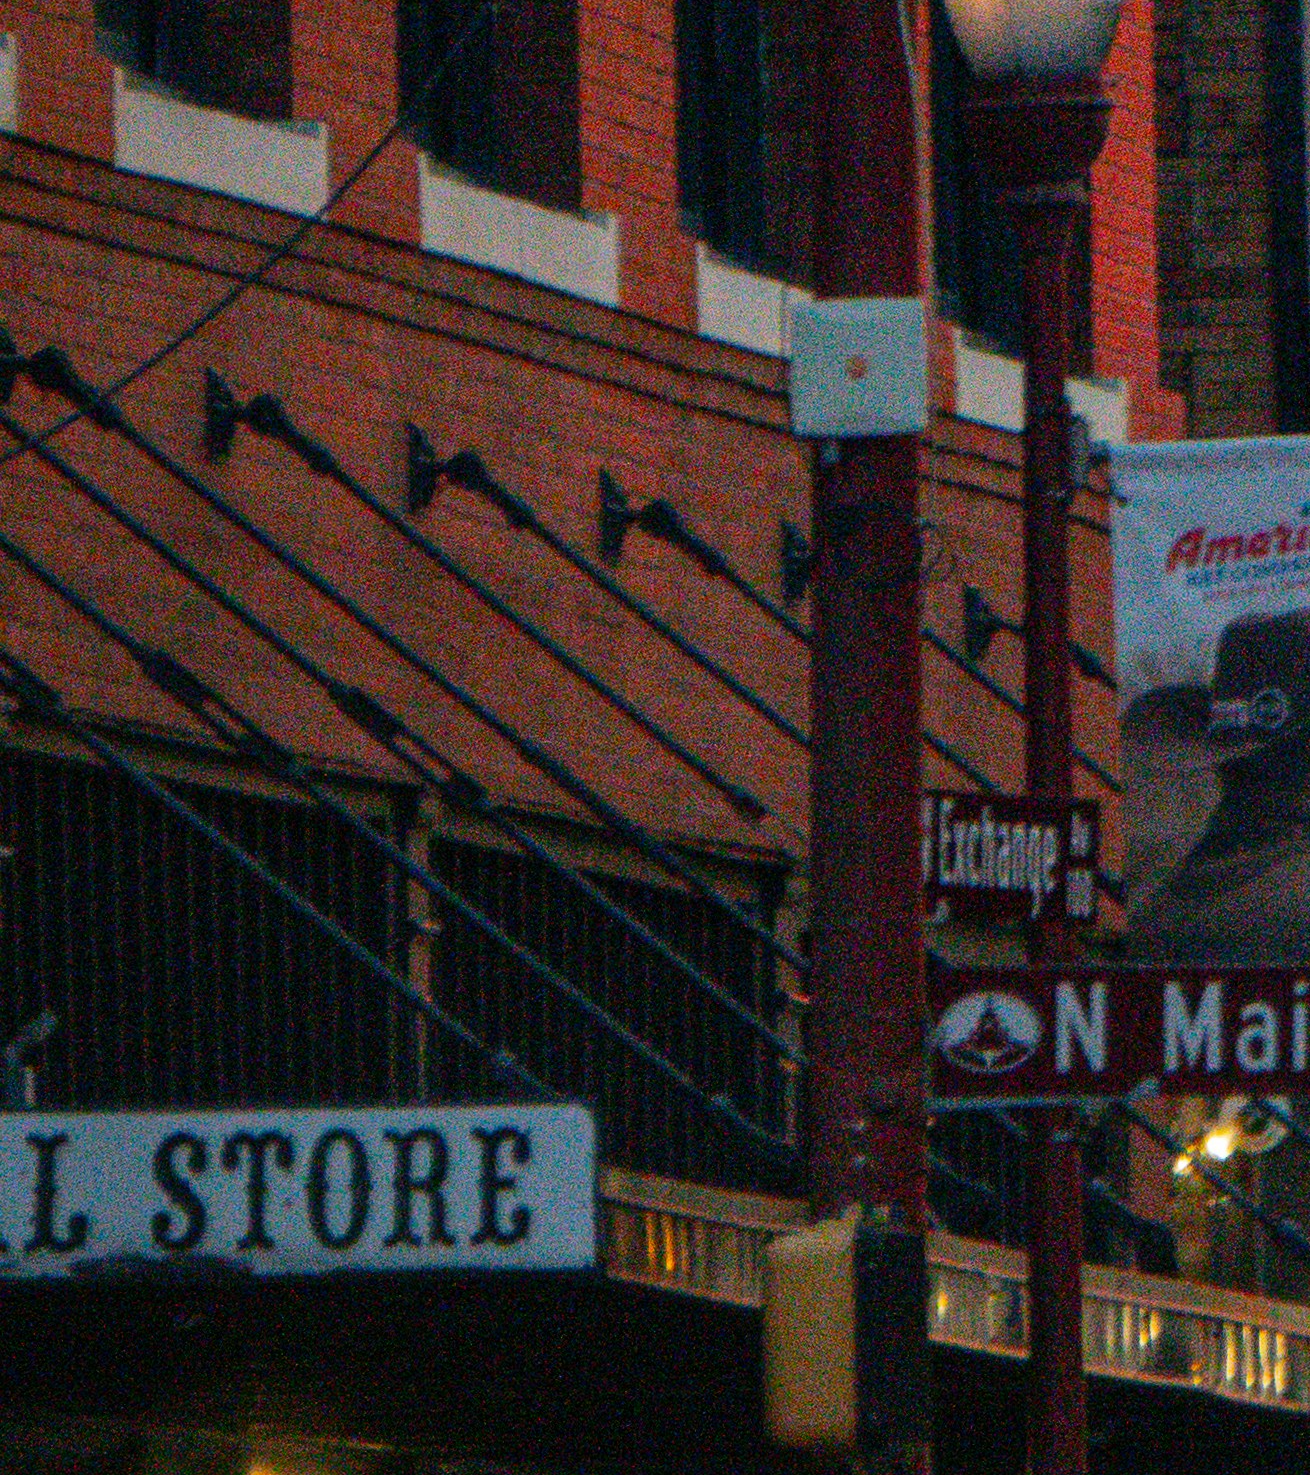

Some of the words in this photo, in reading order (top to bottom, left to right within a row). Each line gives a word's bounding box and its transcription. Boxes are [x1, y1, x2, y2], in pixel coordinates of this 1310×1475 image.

[937, 798, 1058, 921] Exchange
[1054, 982, 1106, 1073] N
[0, 1130, 90, 1253] L
[151, 1126, 534, 1252] STORE
